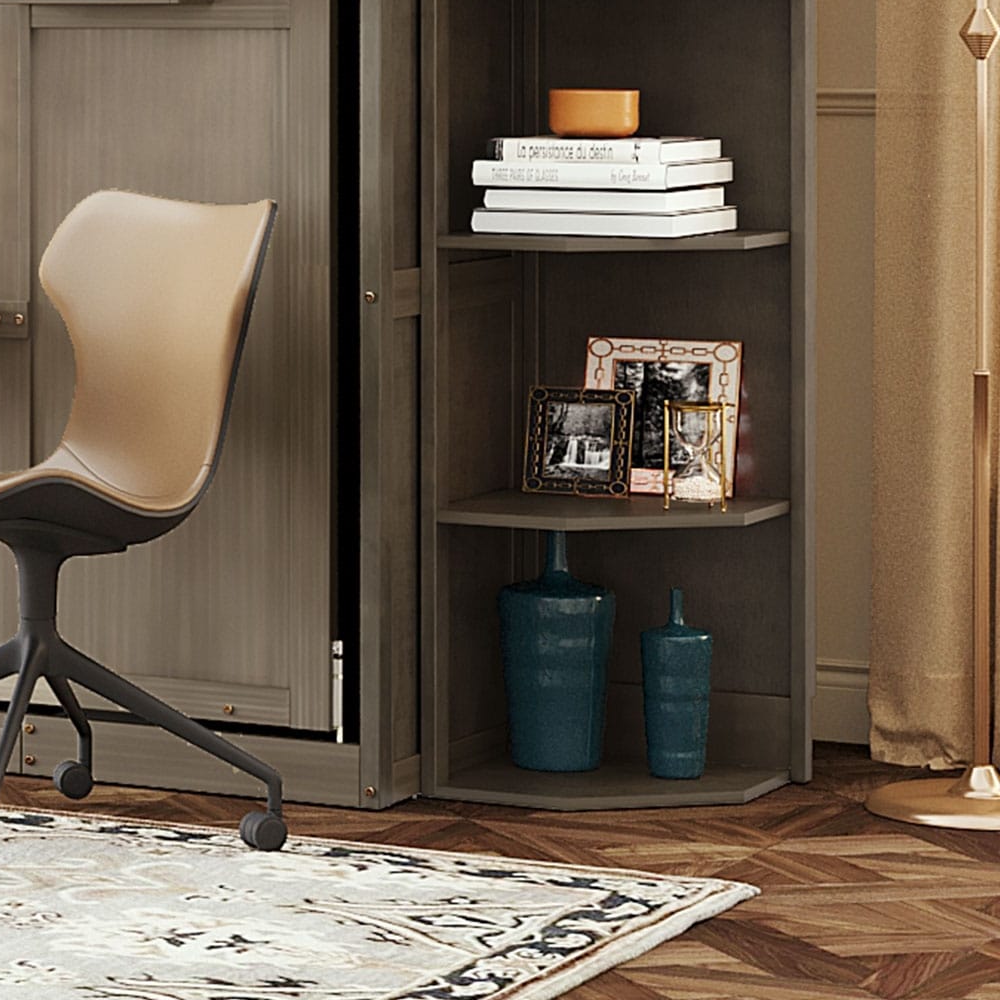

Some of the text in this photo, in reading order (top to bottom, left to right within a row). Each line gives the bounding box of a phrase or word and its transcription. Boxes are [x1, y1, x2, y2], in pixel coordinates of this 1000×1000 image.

[517, 142, 526, 158] La
[576, 144, 587, 159] du
[589, 144, 614, 160] destin
